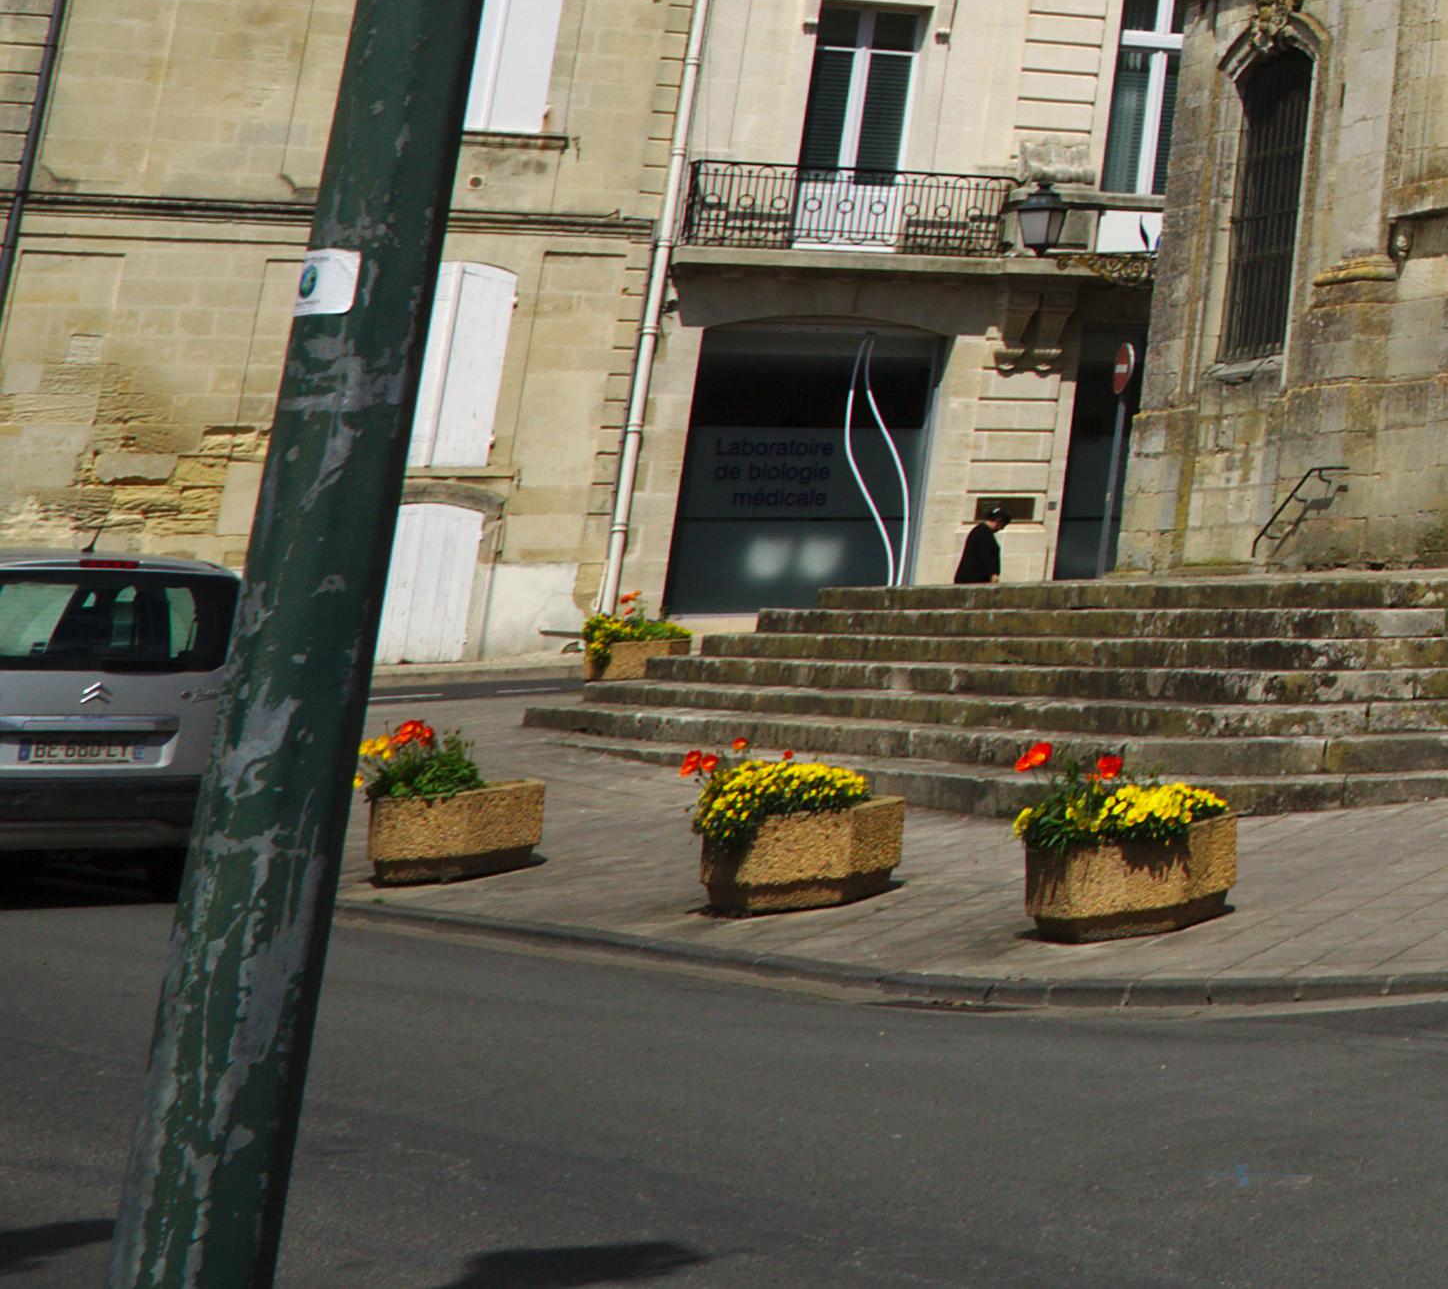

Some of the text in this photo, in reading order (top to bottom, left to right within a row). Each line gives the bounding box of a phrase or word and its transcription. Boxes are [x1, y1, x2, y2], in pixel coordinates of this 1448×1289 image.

[715, 437, 835, 457] Laboratoire
[714, 461, 832, 485] de biologie
[730, 485, 829, 508] médicale
